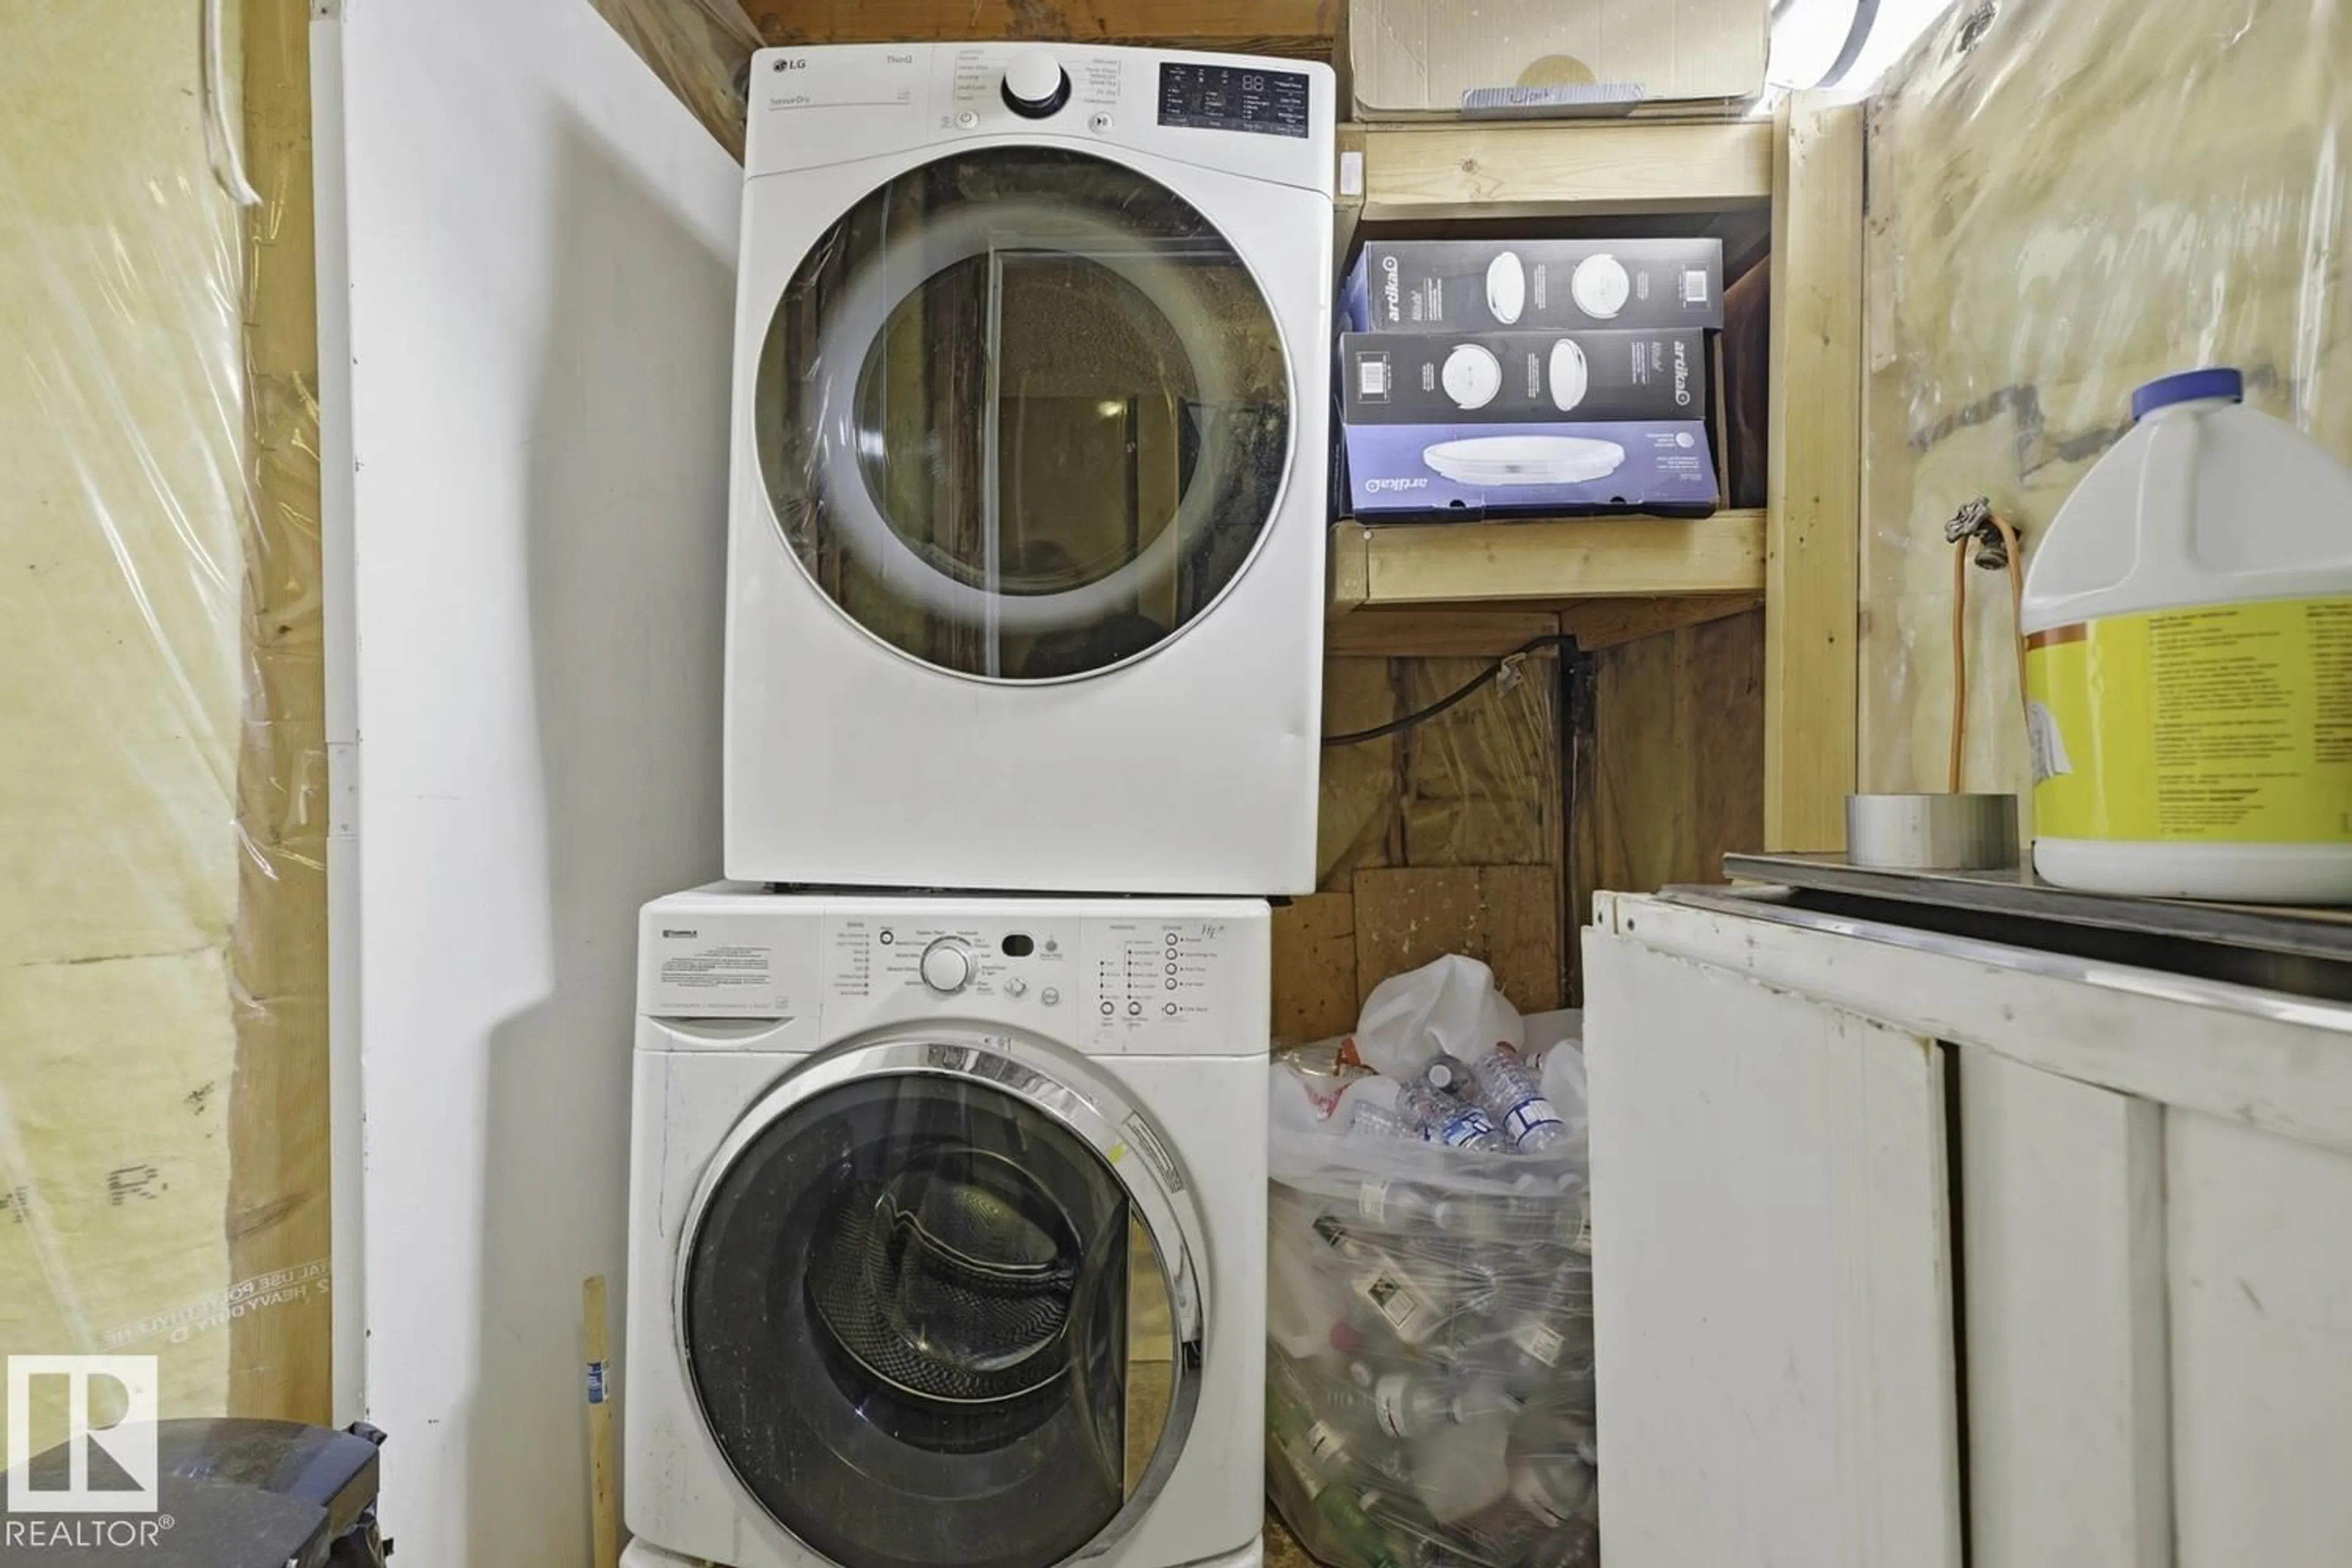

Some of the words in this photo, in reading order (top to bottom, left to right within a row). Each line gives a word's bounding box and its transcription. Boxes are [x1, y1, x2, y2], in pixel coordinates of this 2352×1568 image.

[789, 59, 806, 70] LG
[1673, 340, 1691, 391] artika
[1378, 478, 1428, 491] artika
